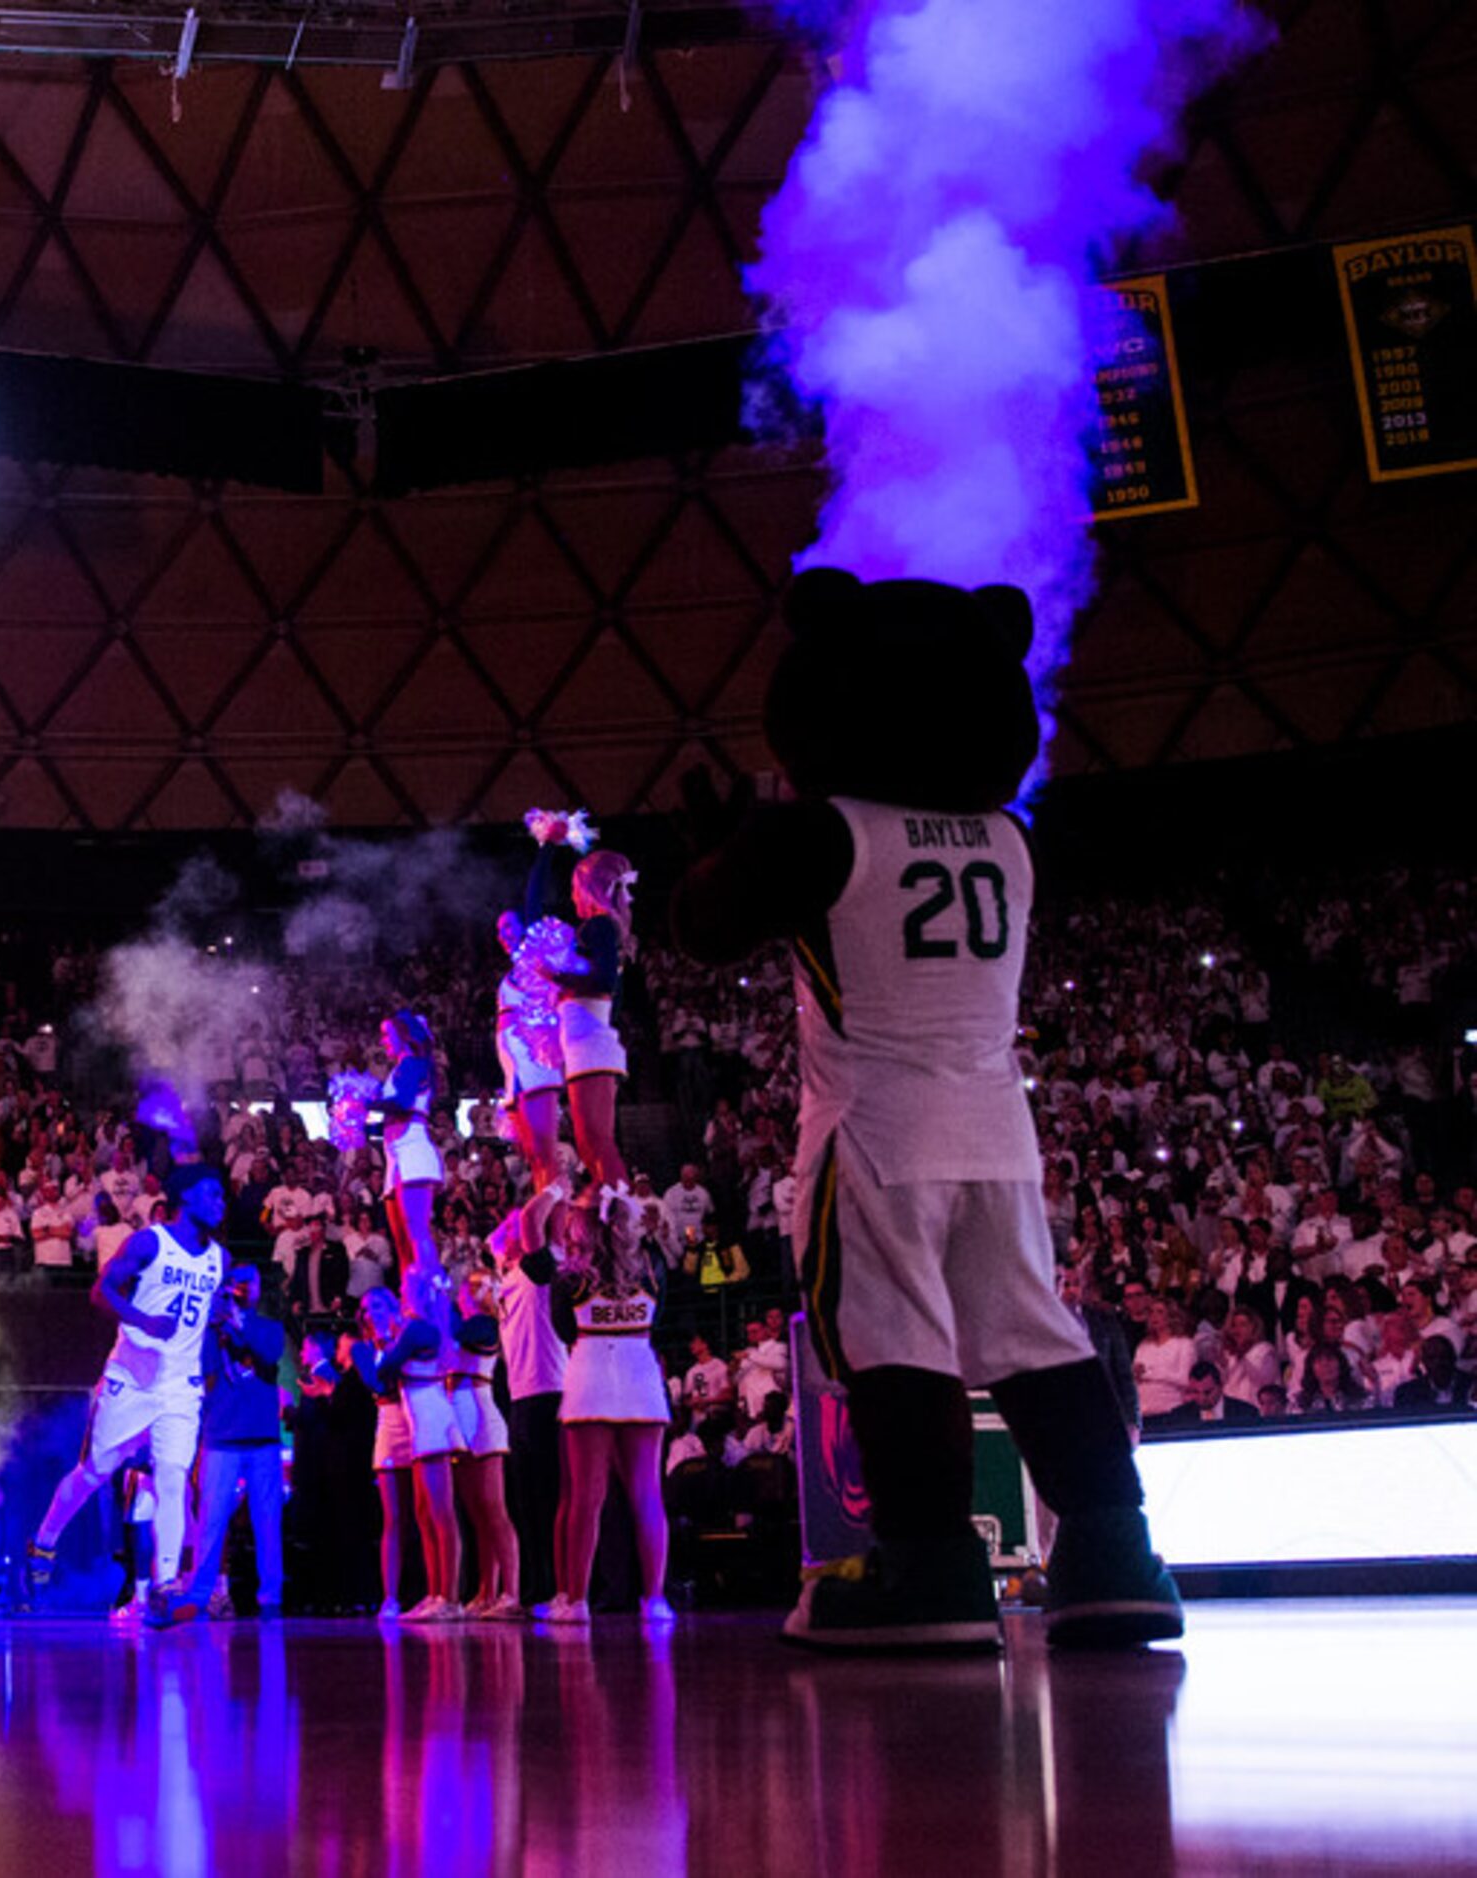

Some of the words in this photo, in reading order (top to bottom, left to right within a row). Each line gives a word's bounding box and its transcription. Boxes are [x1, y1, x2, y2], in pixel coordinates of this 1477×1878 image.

[1346, 241, 1465, 285] BAYLOR
[1381, 411, 1428, 432] 2013
[904, 817, 991, 849] BAYLOR
[899, 860, 1009, 960] 20
[162, 1265, 216, 1294] BAYLOR
[166, 1291, 203, 1327] 45
[591, 1303, 648, 1325] BEARS
